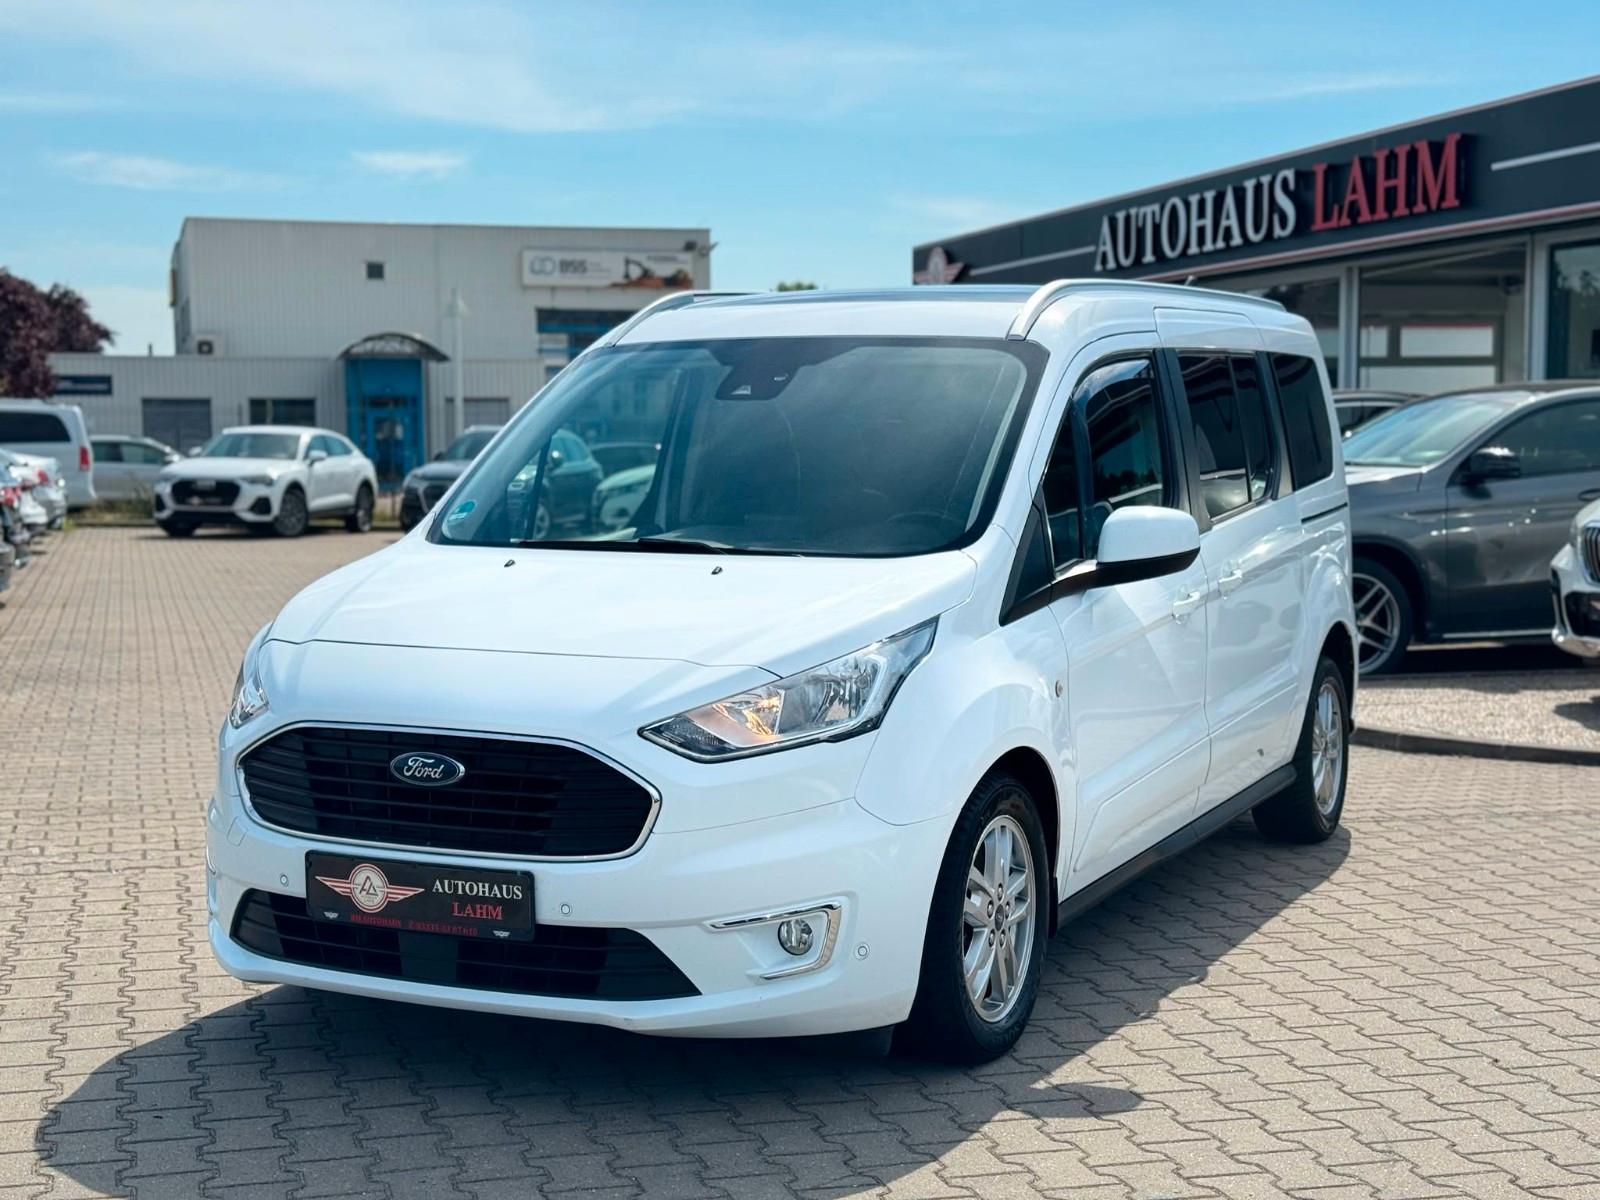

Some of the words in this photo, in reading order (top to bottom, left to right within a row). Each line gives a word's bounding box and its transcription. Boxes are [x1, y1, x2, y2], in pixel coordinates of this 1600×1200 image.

[1094, 168, 1297, 272] AUTOHAUS
[1311, 132, 1462, 232] LAHM
[403, 756, 445, 779] Ford
[432, 879, 523, 900] AUTOHAUS
[452, 901, 503, 920] LAHM
